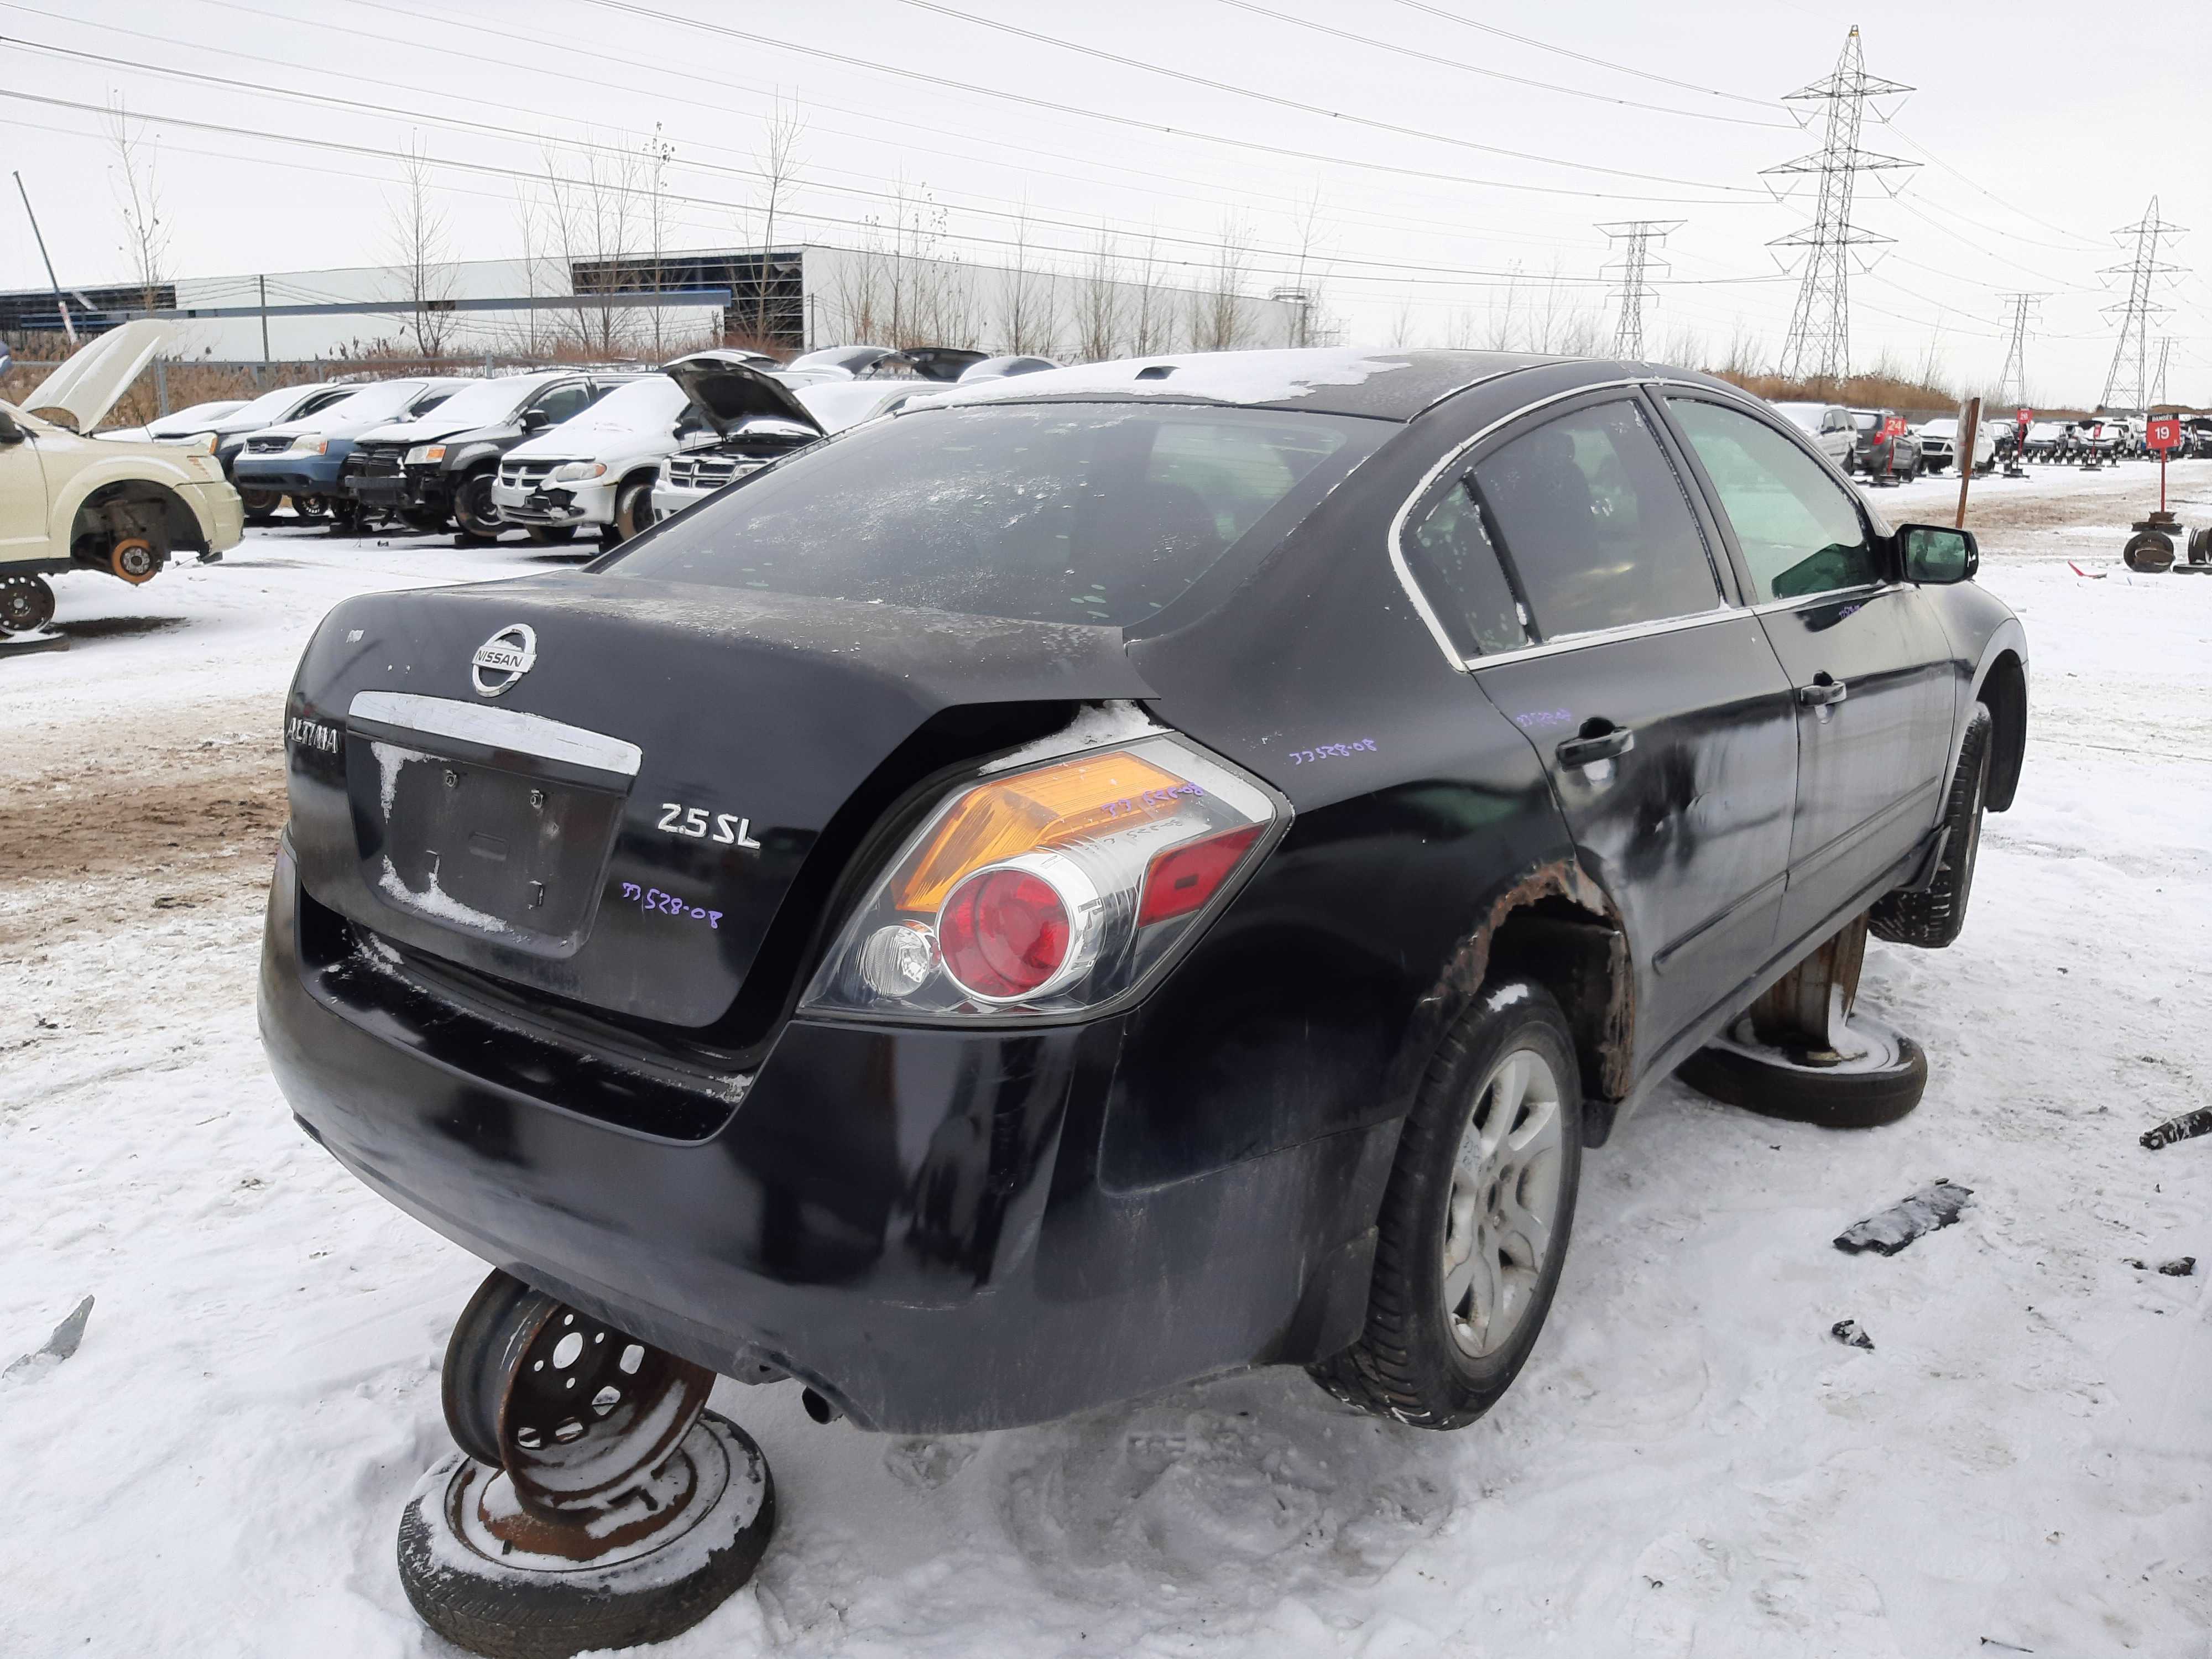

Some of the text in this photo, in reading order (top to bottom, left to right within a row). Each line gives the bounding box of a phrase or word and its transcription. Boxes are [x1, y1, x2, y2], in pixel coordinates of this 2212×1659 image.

[1887, 420, 1902, 431] 24
[2154, 426, 2169, 440] 19
[475, 650, 524, 667] NISSAN
[286, 717, 338, 754] ALTIMA
[712, 813, 761, 849] SL
